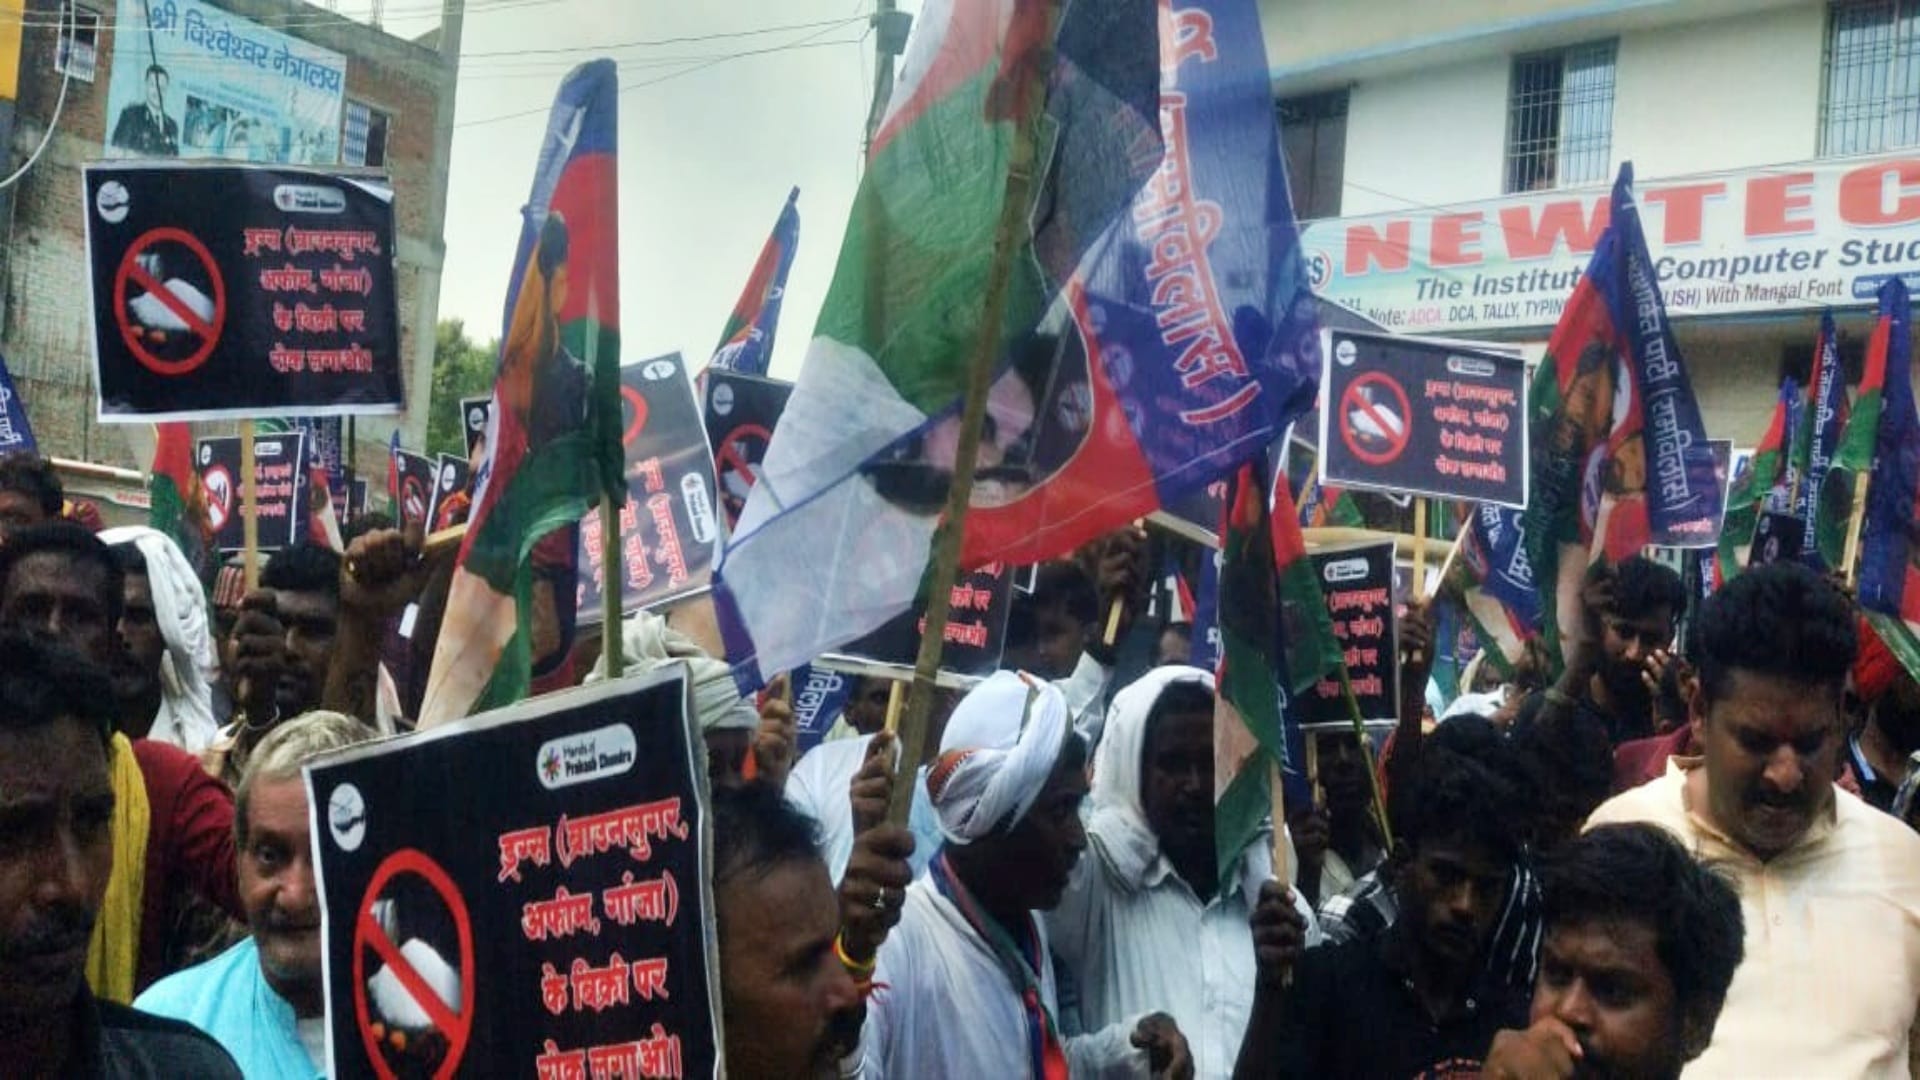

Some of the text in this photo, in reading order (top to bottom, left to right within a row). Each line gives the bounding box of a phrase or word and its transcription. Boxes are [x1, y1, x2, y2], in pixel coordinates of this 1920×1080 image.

[150, 1, 178, 37] श्री
[273, 43, 342, 94] नेत्रालय
[1416, 278, 1463, 300] The
[1472, 265, 1582, 297] Institut
[1655, 247, 1829, 282] Computer
[1525, 298, 1567, 317] TYPIN
[1664, 287, 1703, 310] LISH)
[1706, 284, 1741, 304] With
[1745, 279, 1803, 305] Mangal
[1807, 278, 1843, 299] Font
[521, 869, 679, 940] अफीम, गांजा)
[541, 952, 669, 1015] के बिक्री पर
